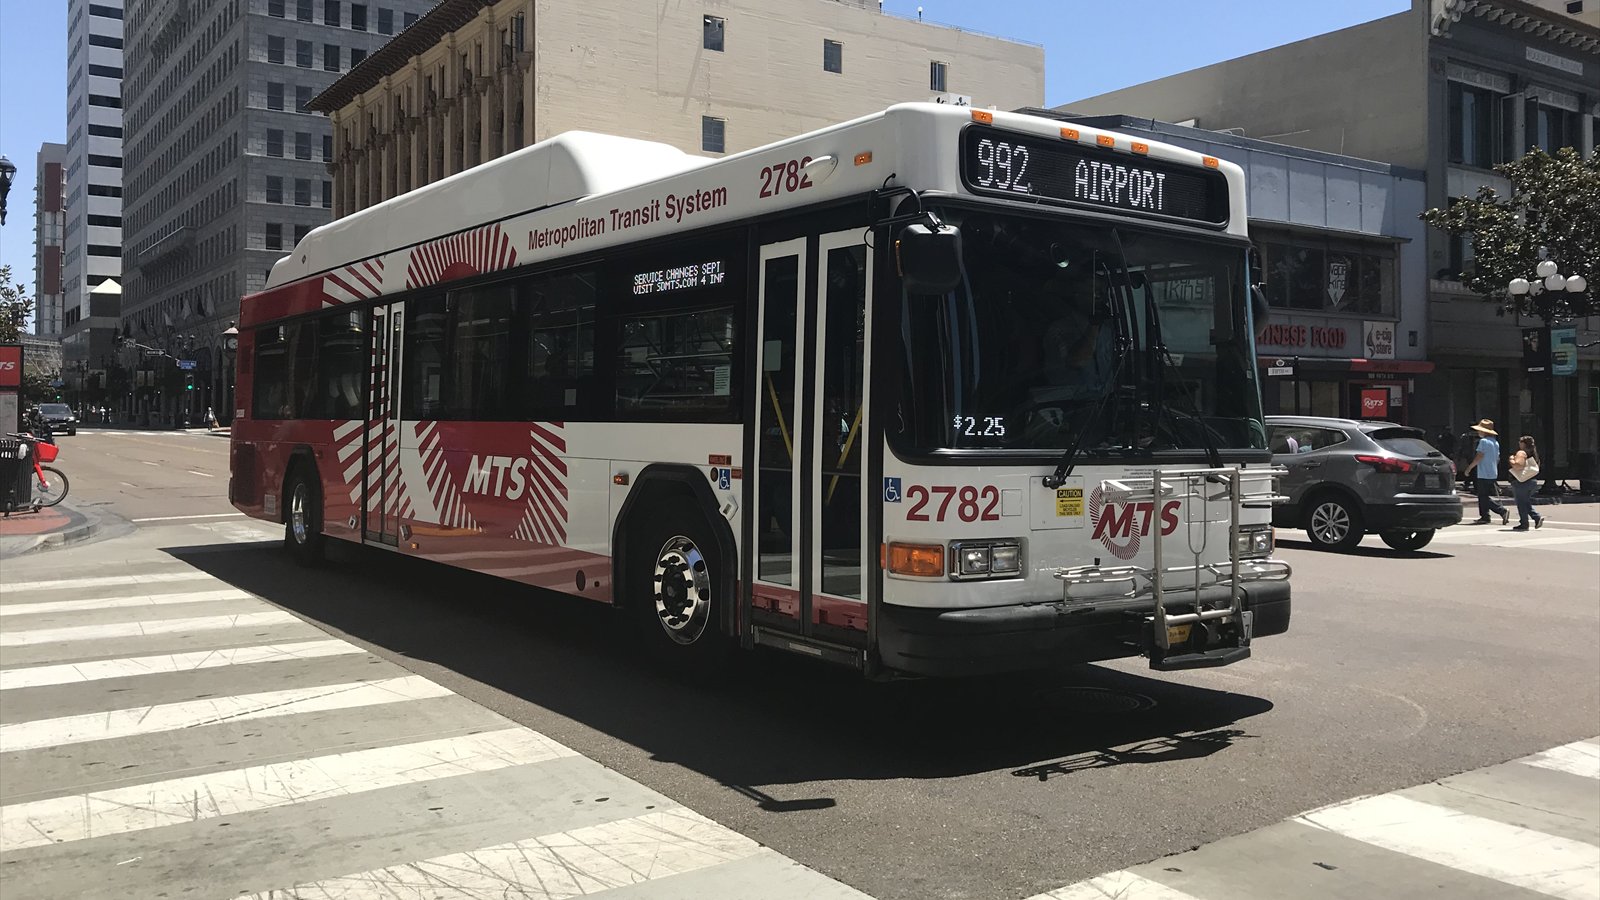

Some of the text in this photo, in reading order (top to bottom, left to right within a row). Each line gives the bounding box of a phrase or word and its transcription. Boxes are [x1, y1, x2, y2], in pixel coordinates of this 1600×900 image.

[759, 156, 813, 198] 2782
[977, 139, 1166, 210] 992 AIRPORT
[528, 186, 728, 251] Metropolitan Transit System
[633, 272, 725, 295] VISIT SDMTS.COM 4 INF
[634, 261, 721, 285] SERVICE CHANGES SEPT
[1311, 327, 1345, 347] FOOD
[1364, 398, 1384, 408] MTS
[953, 414, 1006, 436] $2.25
[462, 454, 529, 500] MTS
[906, 485, 1000, 522] 2782
[1091, 500, 1182, 540] MTS
